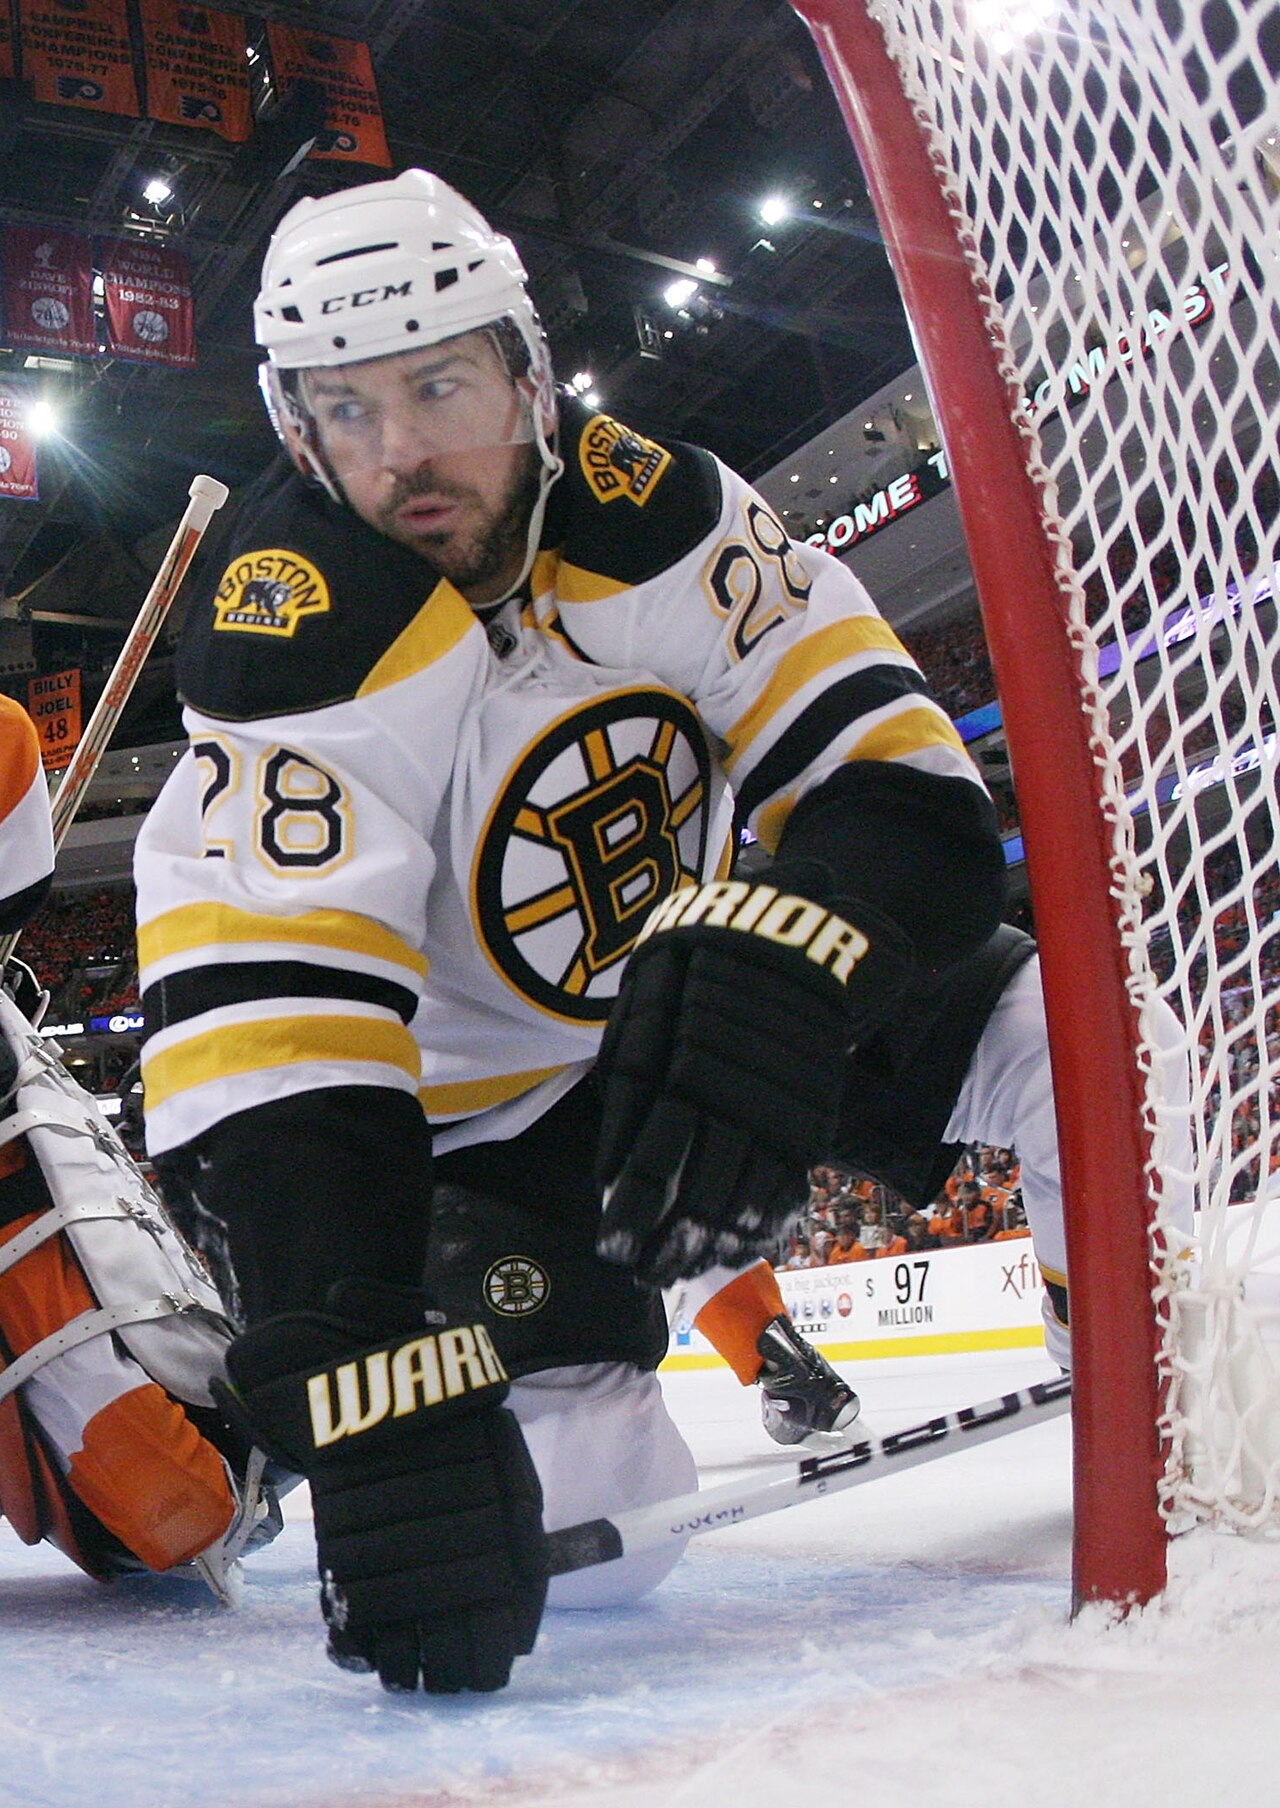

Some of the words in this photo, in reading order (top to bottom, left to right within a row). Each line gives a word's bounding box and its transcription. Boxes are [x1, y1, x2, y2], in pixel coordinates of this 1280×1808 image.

[103, 272, 193, 298] CHAMPIONS
[321, 280, 413, 315] CCM
[118, 288, 181, 310] 1982-83
[218, 556, 321, 610] BOSTON
[34, 673, 74, 695] BILLY
[36, 696, 73, 718] JOEL
[44, 718, 69, 743] 48
[894, 1261, 930, 1305] 97
[877, 1305, 934, 1327] MILLION
[307, 1324, 510, 1448] WARR
